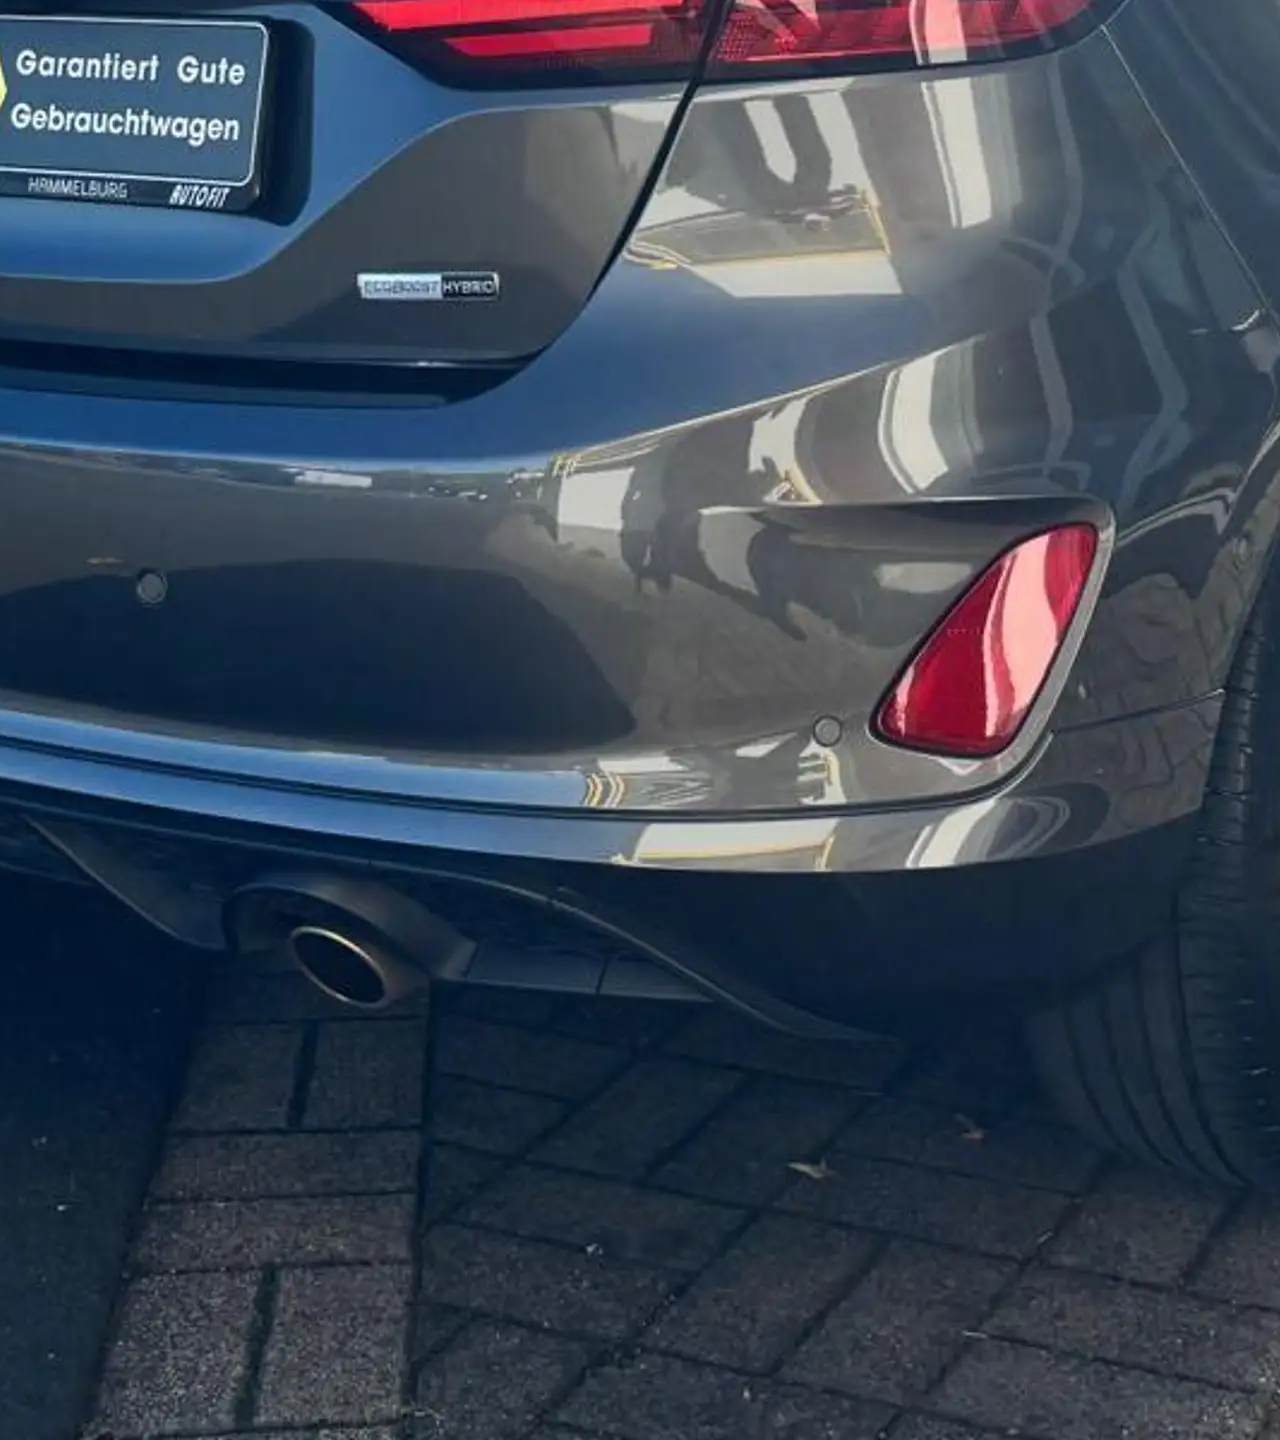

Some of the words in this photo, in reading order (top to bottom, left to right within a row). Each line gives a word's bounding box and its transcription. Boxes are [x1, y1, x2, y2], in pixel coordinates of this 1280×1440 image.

[16, 48, 159, 82] Garantiert
[177, 55, 246, 86] Gute
[11, 102, 239, 147] Gebrauchtwagen
[28, 175, 129, 200] HAMMELBURG
[169, 184, 231, 209] AUTOFIT
[443, 280, 497, 295] HYBRID
